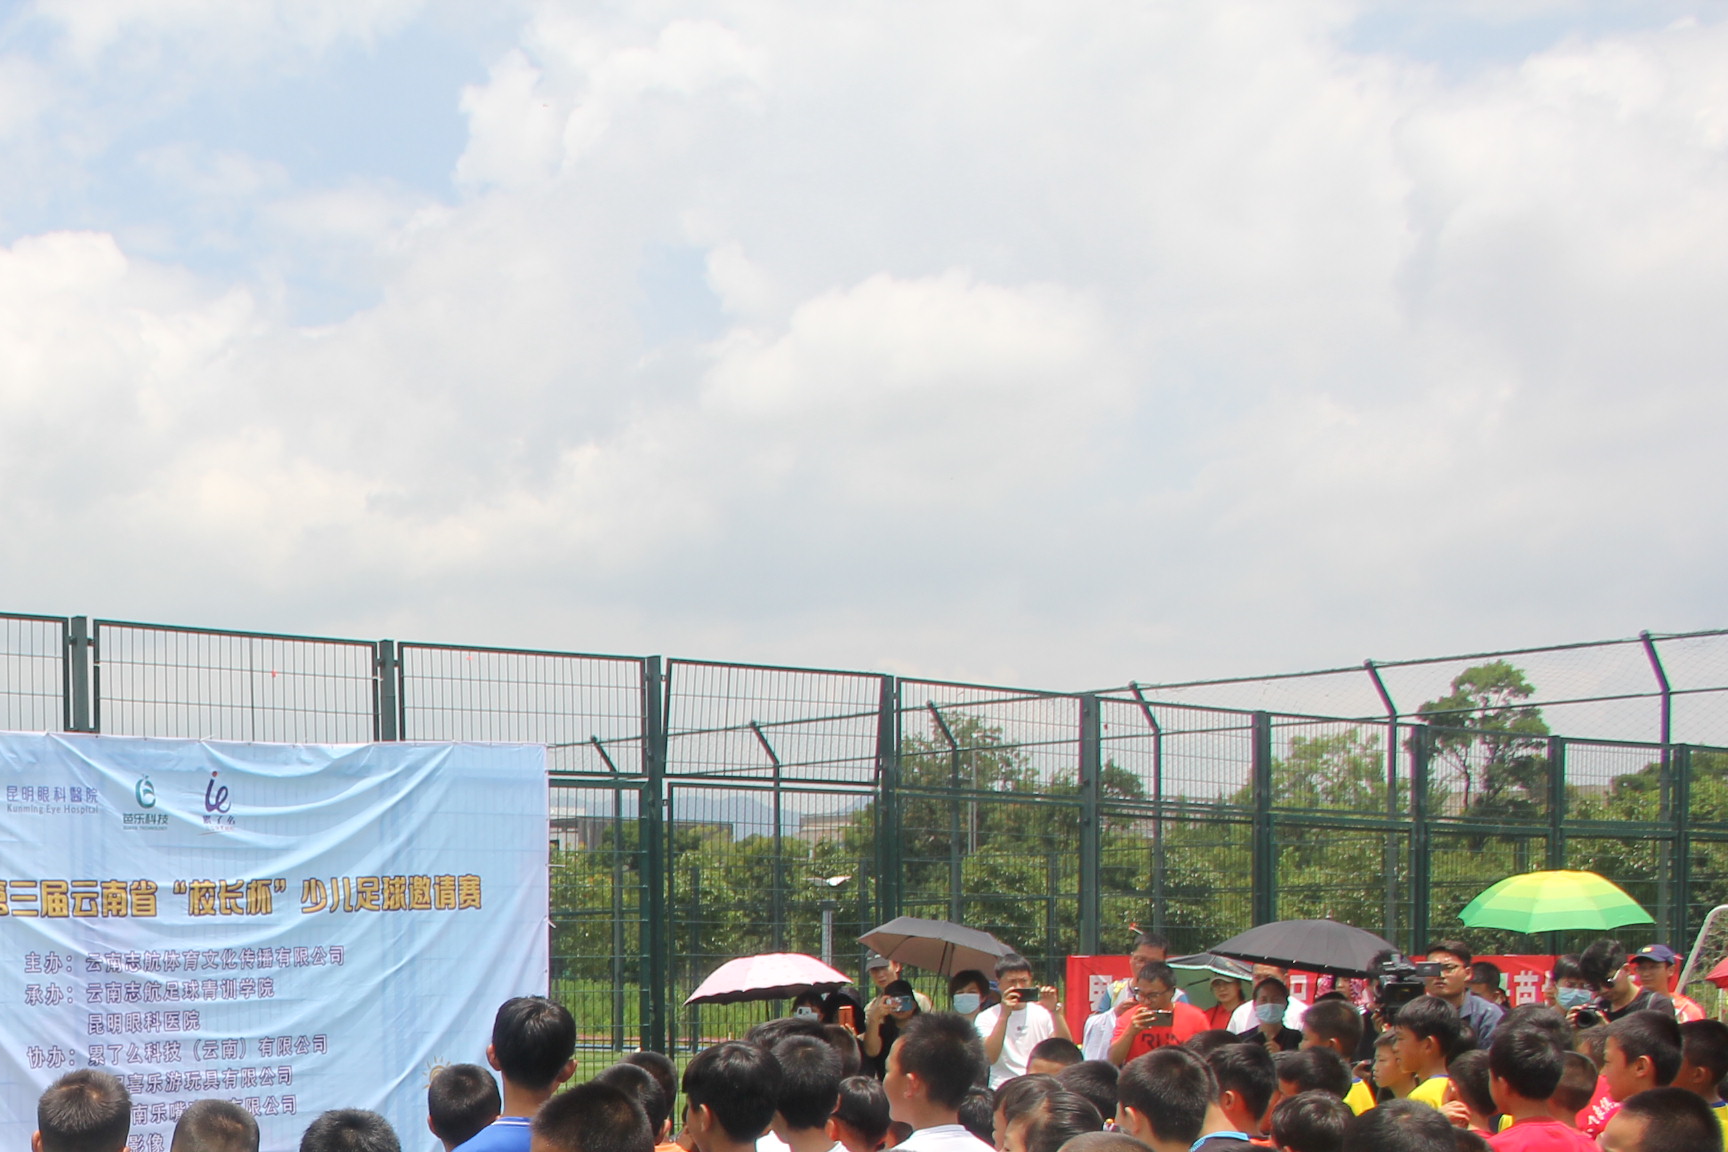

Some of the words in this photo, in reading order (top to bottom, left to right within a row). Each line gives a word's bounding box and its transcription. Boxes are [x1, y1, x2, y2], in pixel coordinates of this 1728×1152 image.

[6, 785, 98, 803] 昆明眼科醫院
[7, 804, 44, 814] Kunming
[46, 804, 61, 815] Eye
[64, 804, 99, 815] Hospital
[122, 813, 169, 825] 芭乐科技
[87, 1010, 201, 1036] 昆明眼科医院
